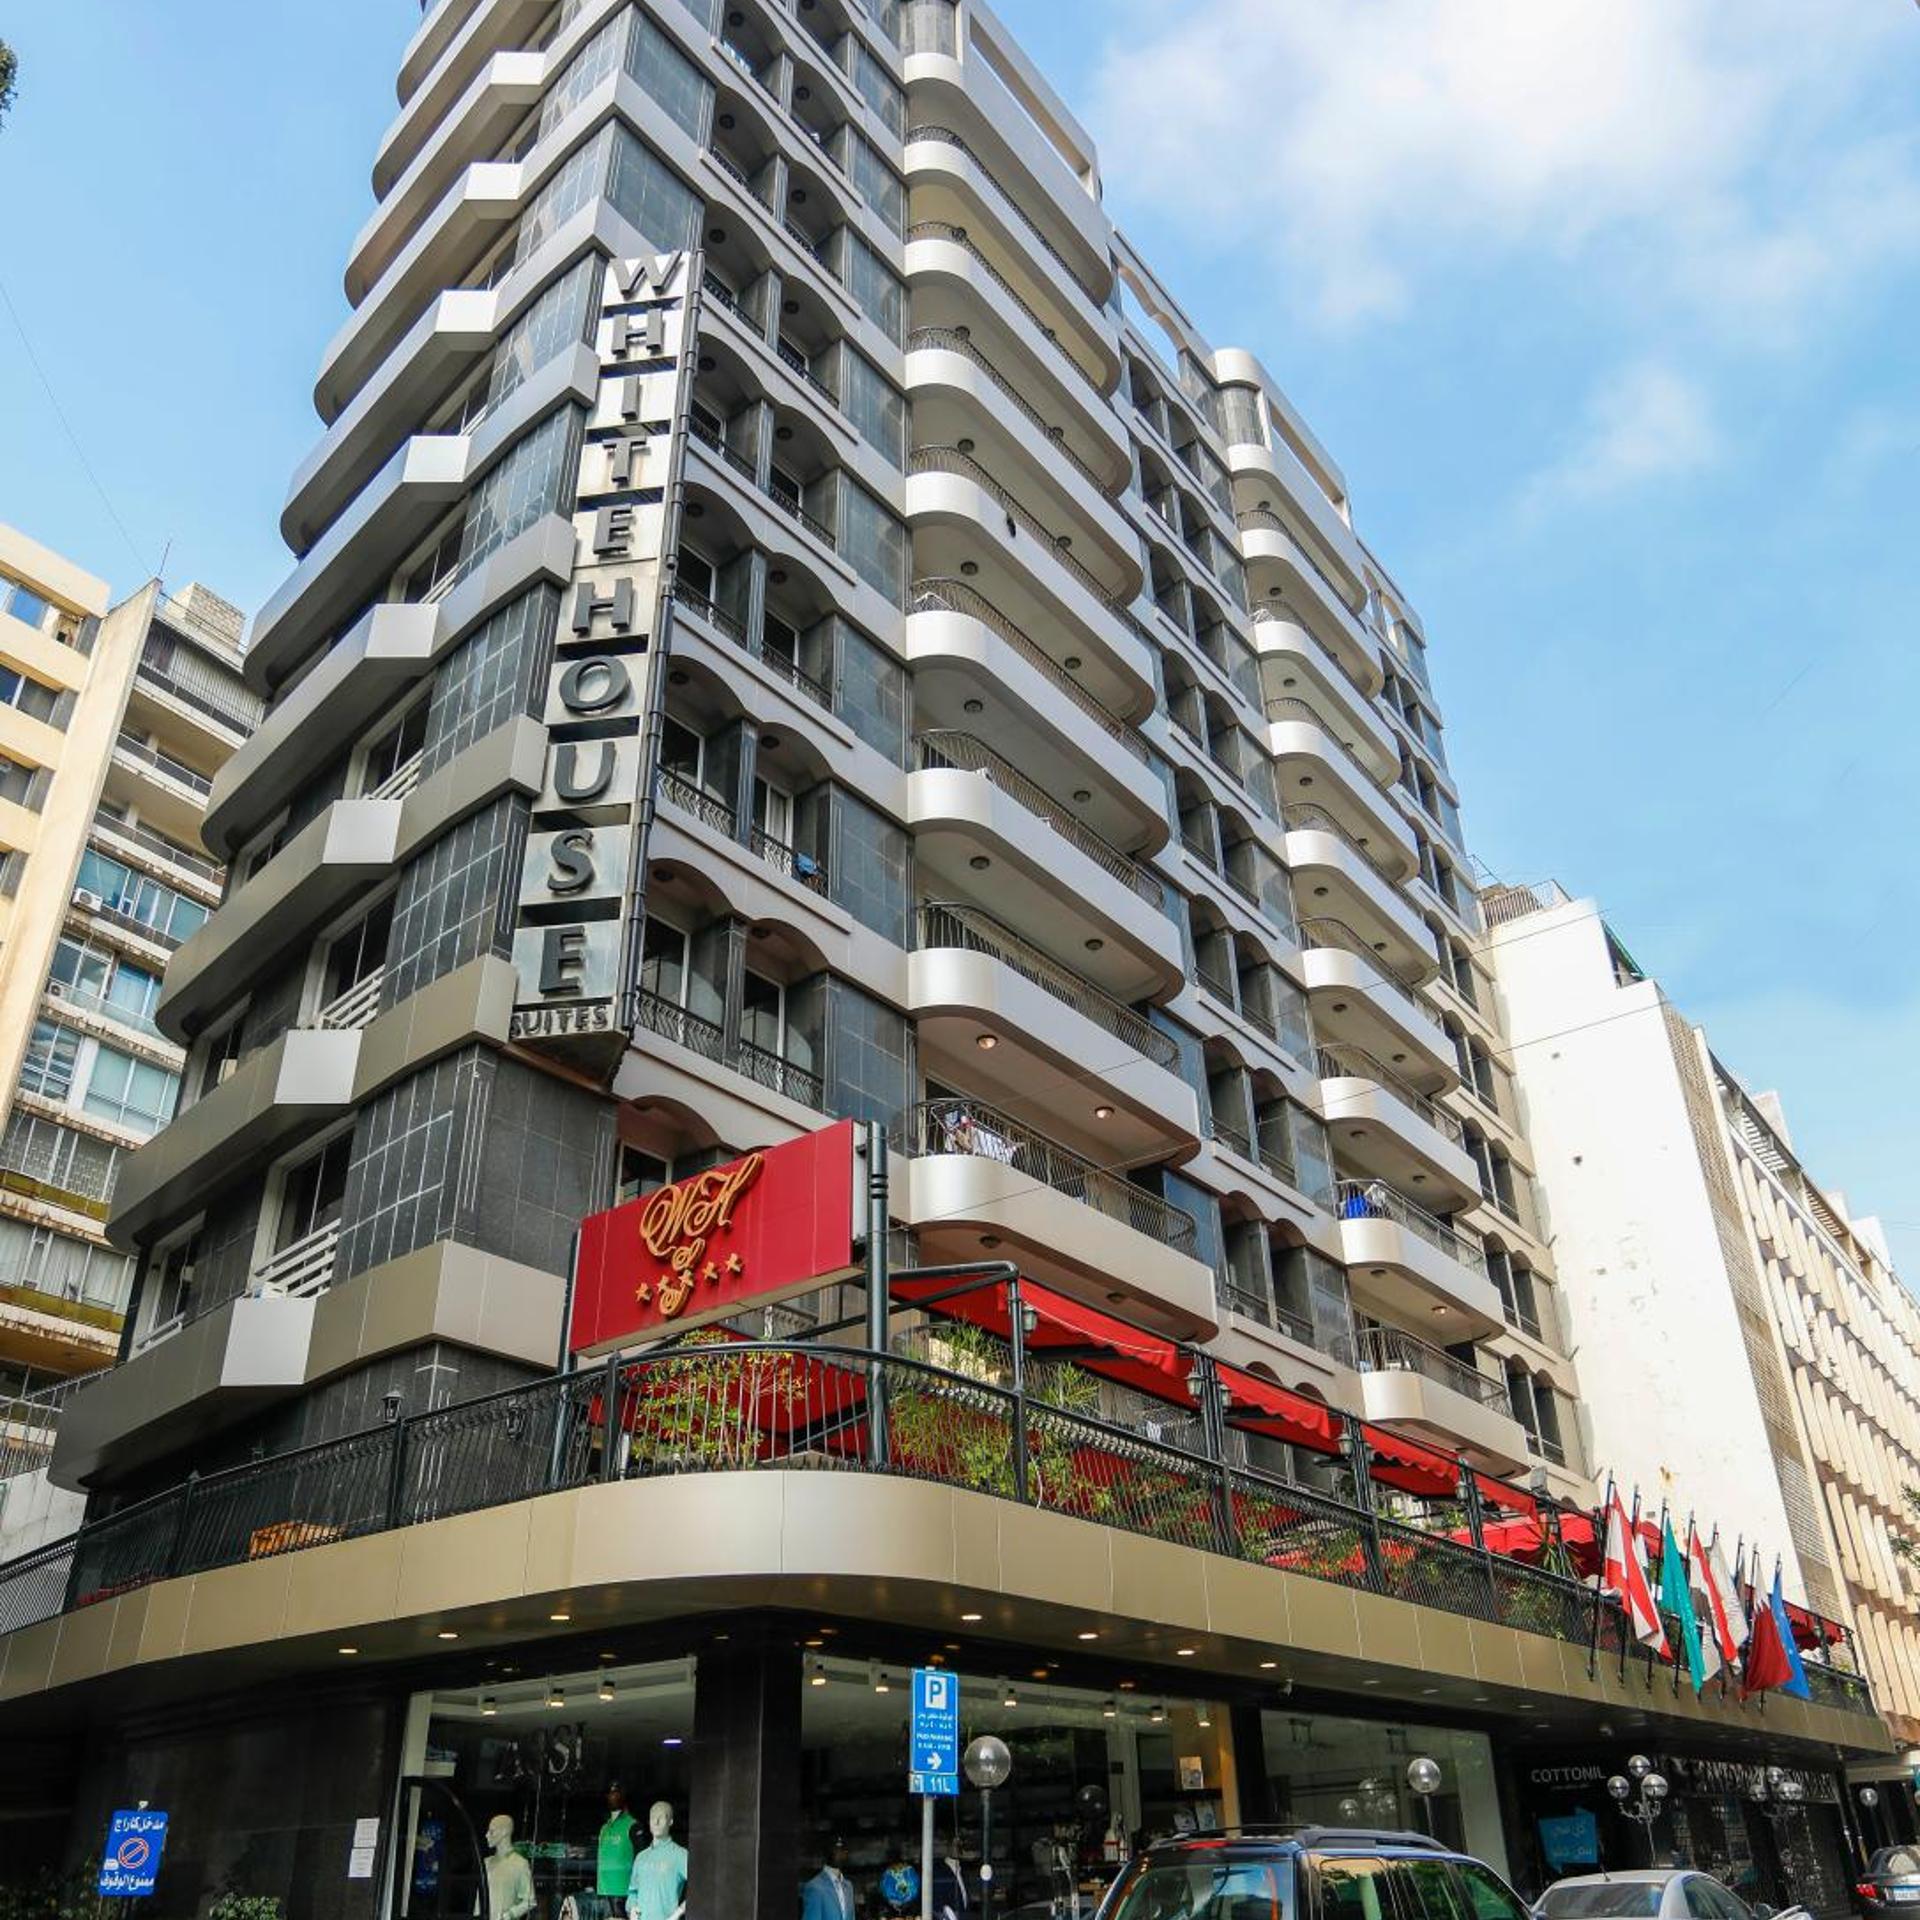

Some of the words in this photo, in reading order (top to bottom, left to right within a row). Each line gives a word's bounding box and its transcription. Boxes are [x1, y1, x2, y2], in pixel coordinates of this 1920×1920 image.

[509, 1005, 609, 1038] SUITES
[930, 1680, 943, 1704] P
[1531, 1766, 1607, 1784] COTTONIL
